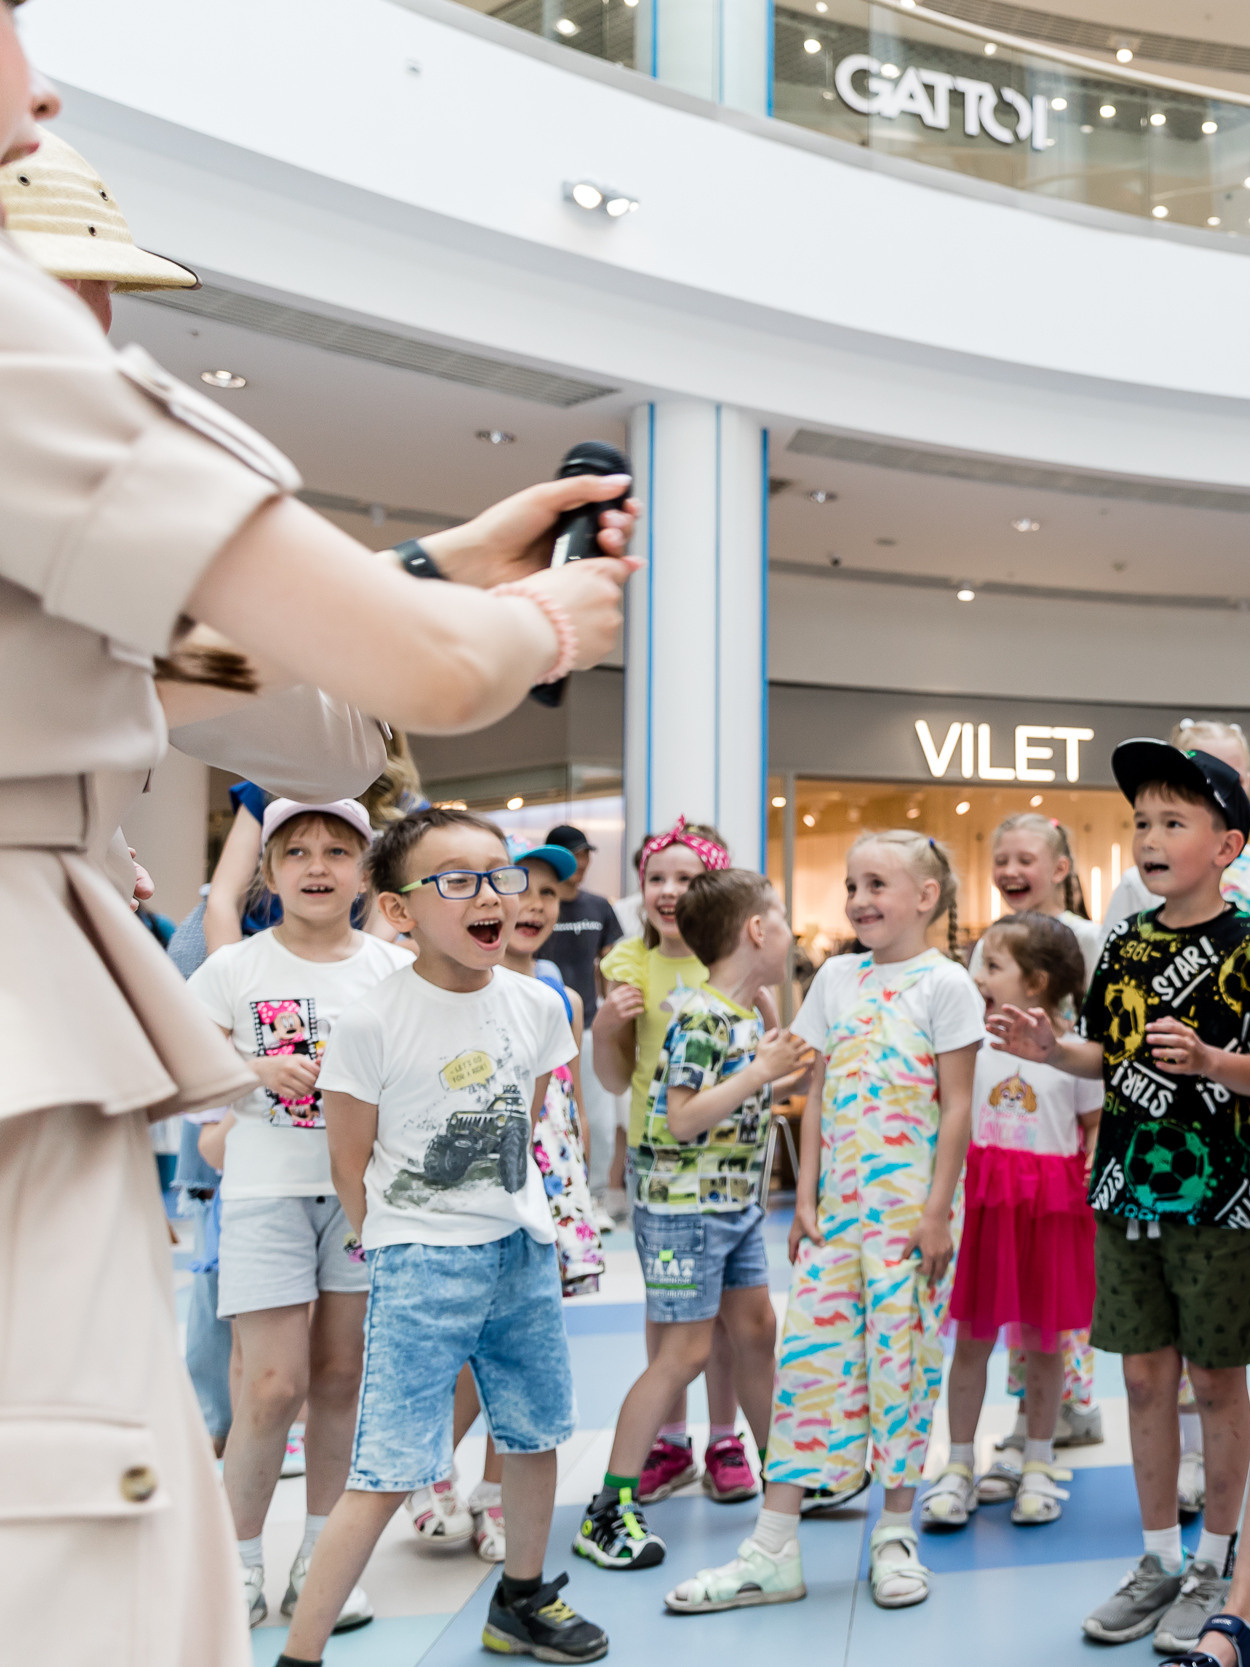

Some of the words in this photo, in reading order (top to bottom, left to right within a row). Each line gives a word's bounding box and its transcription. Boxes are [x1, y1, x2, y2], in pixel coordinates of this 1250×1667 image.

[915, 719, 1095, 784] VILET
[1151, 935, 1219, 1001] STAR!
[1110, 1059, 1174, 1117] STAR!
